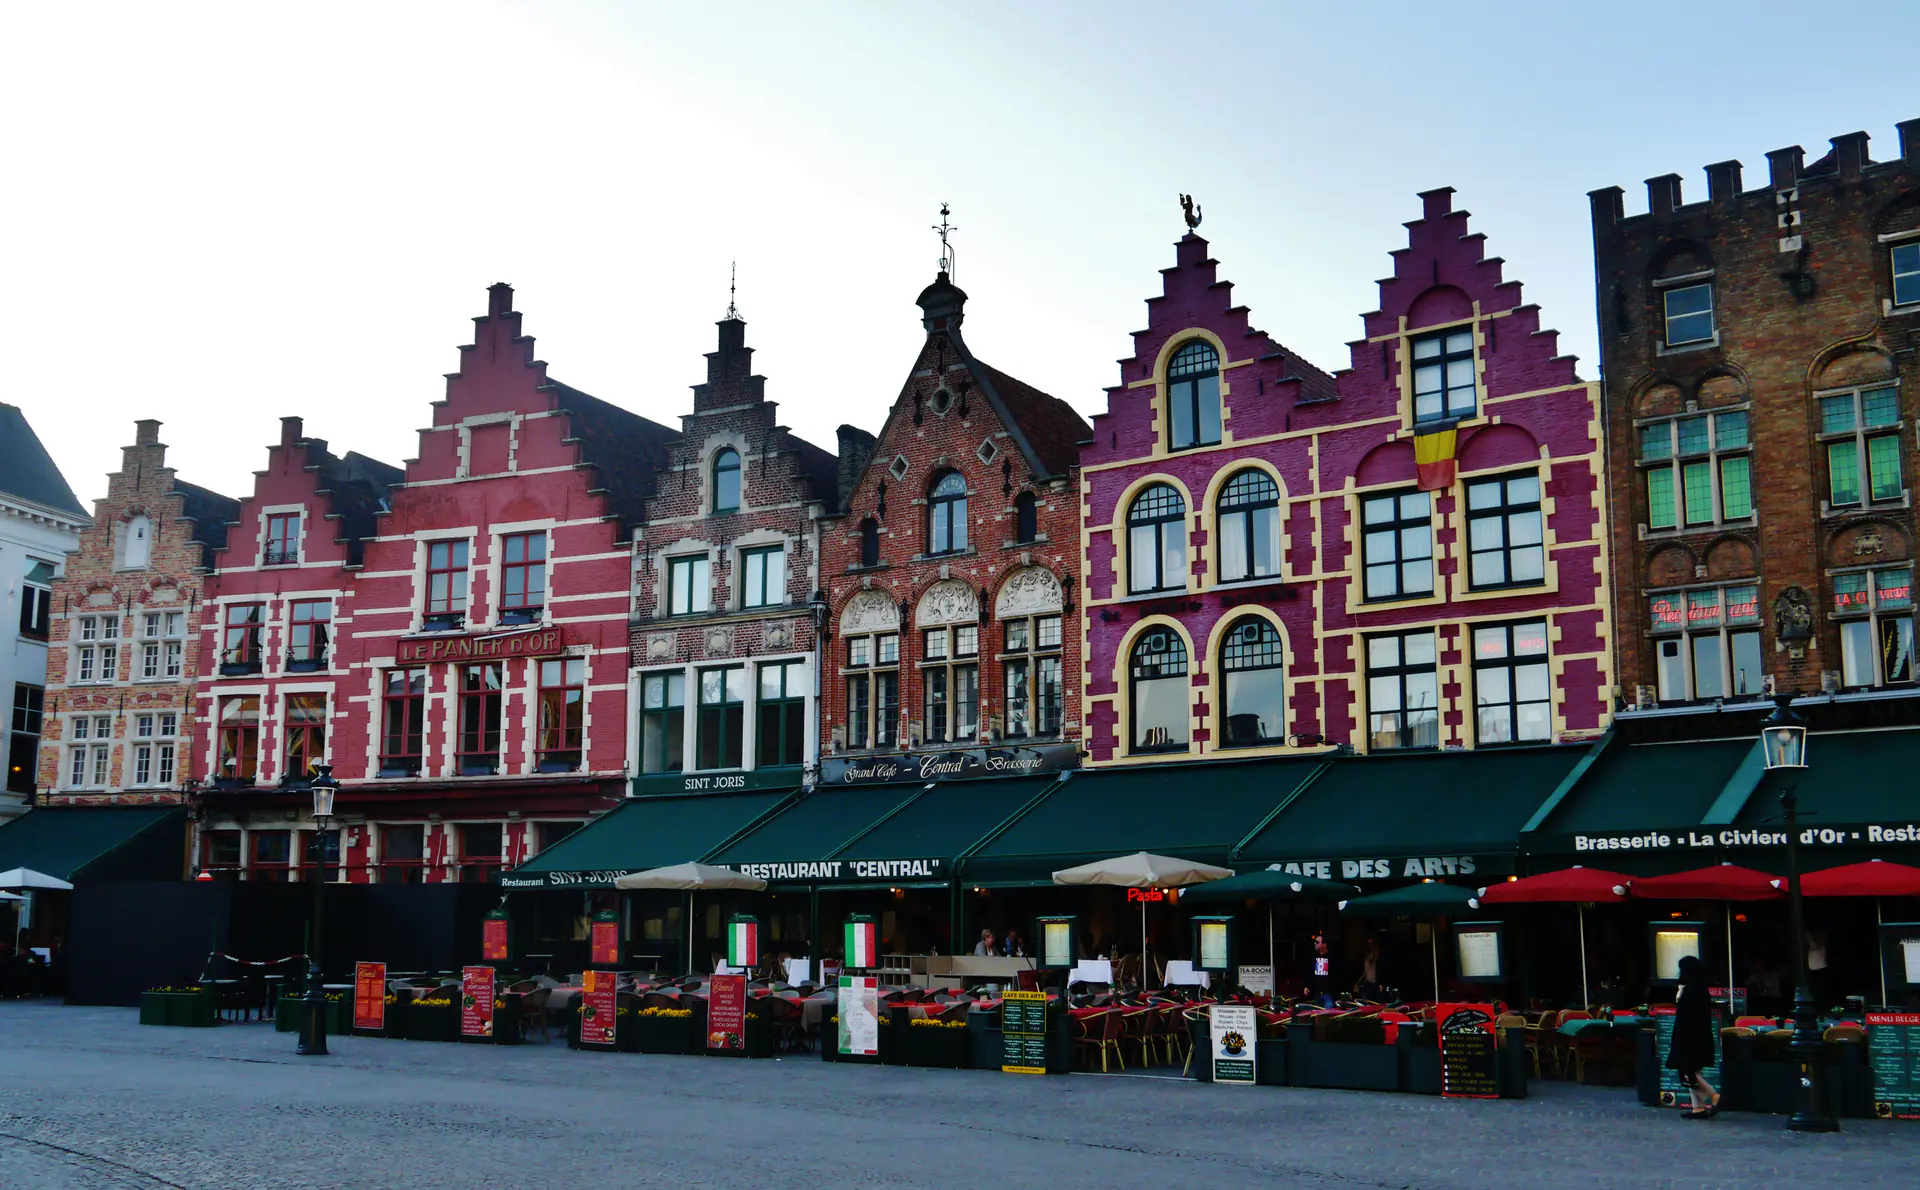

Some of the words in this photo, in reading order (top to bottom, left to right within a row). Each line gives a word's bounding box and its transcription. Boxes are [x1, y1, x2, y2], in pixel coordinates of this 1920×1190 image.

[403, 645, 427, 660] LE
[432, 638, 504, 658] PANIER
[510, 631, 557, 654] D'OR
[844, 764, 874, 783] Grand
[919, 754, 965, 778] Central
[985, 756, 1043, 770] Brasserie
[685, 778, 710, 789] SINT
[713, 776, 745, 788] JORIS
[1575, 832, 1670, 851] Brasserie
[1689, 832, 1714, 847] La
[1800, 827, 1853, 844] d'Or
[740, 862, 842, 880] RESTAURANT
[1342, 859, 1390, 878] DES
[1403, 856, 1476, 877] ARTS
[501, 877, 544, 887] Restaurant
[1128, 887, 1163, 902] Pasta
[1869, 1015, 1893, 1023] MENU
[1895, 1015, 1920, 1023] BELGE
